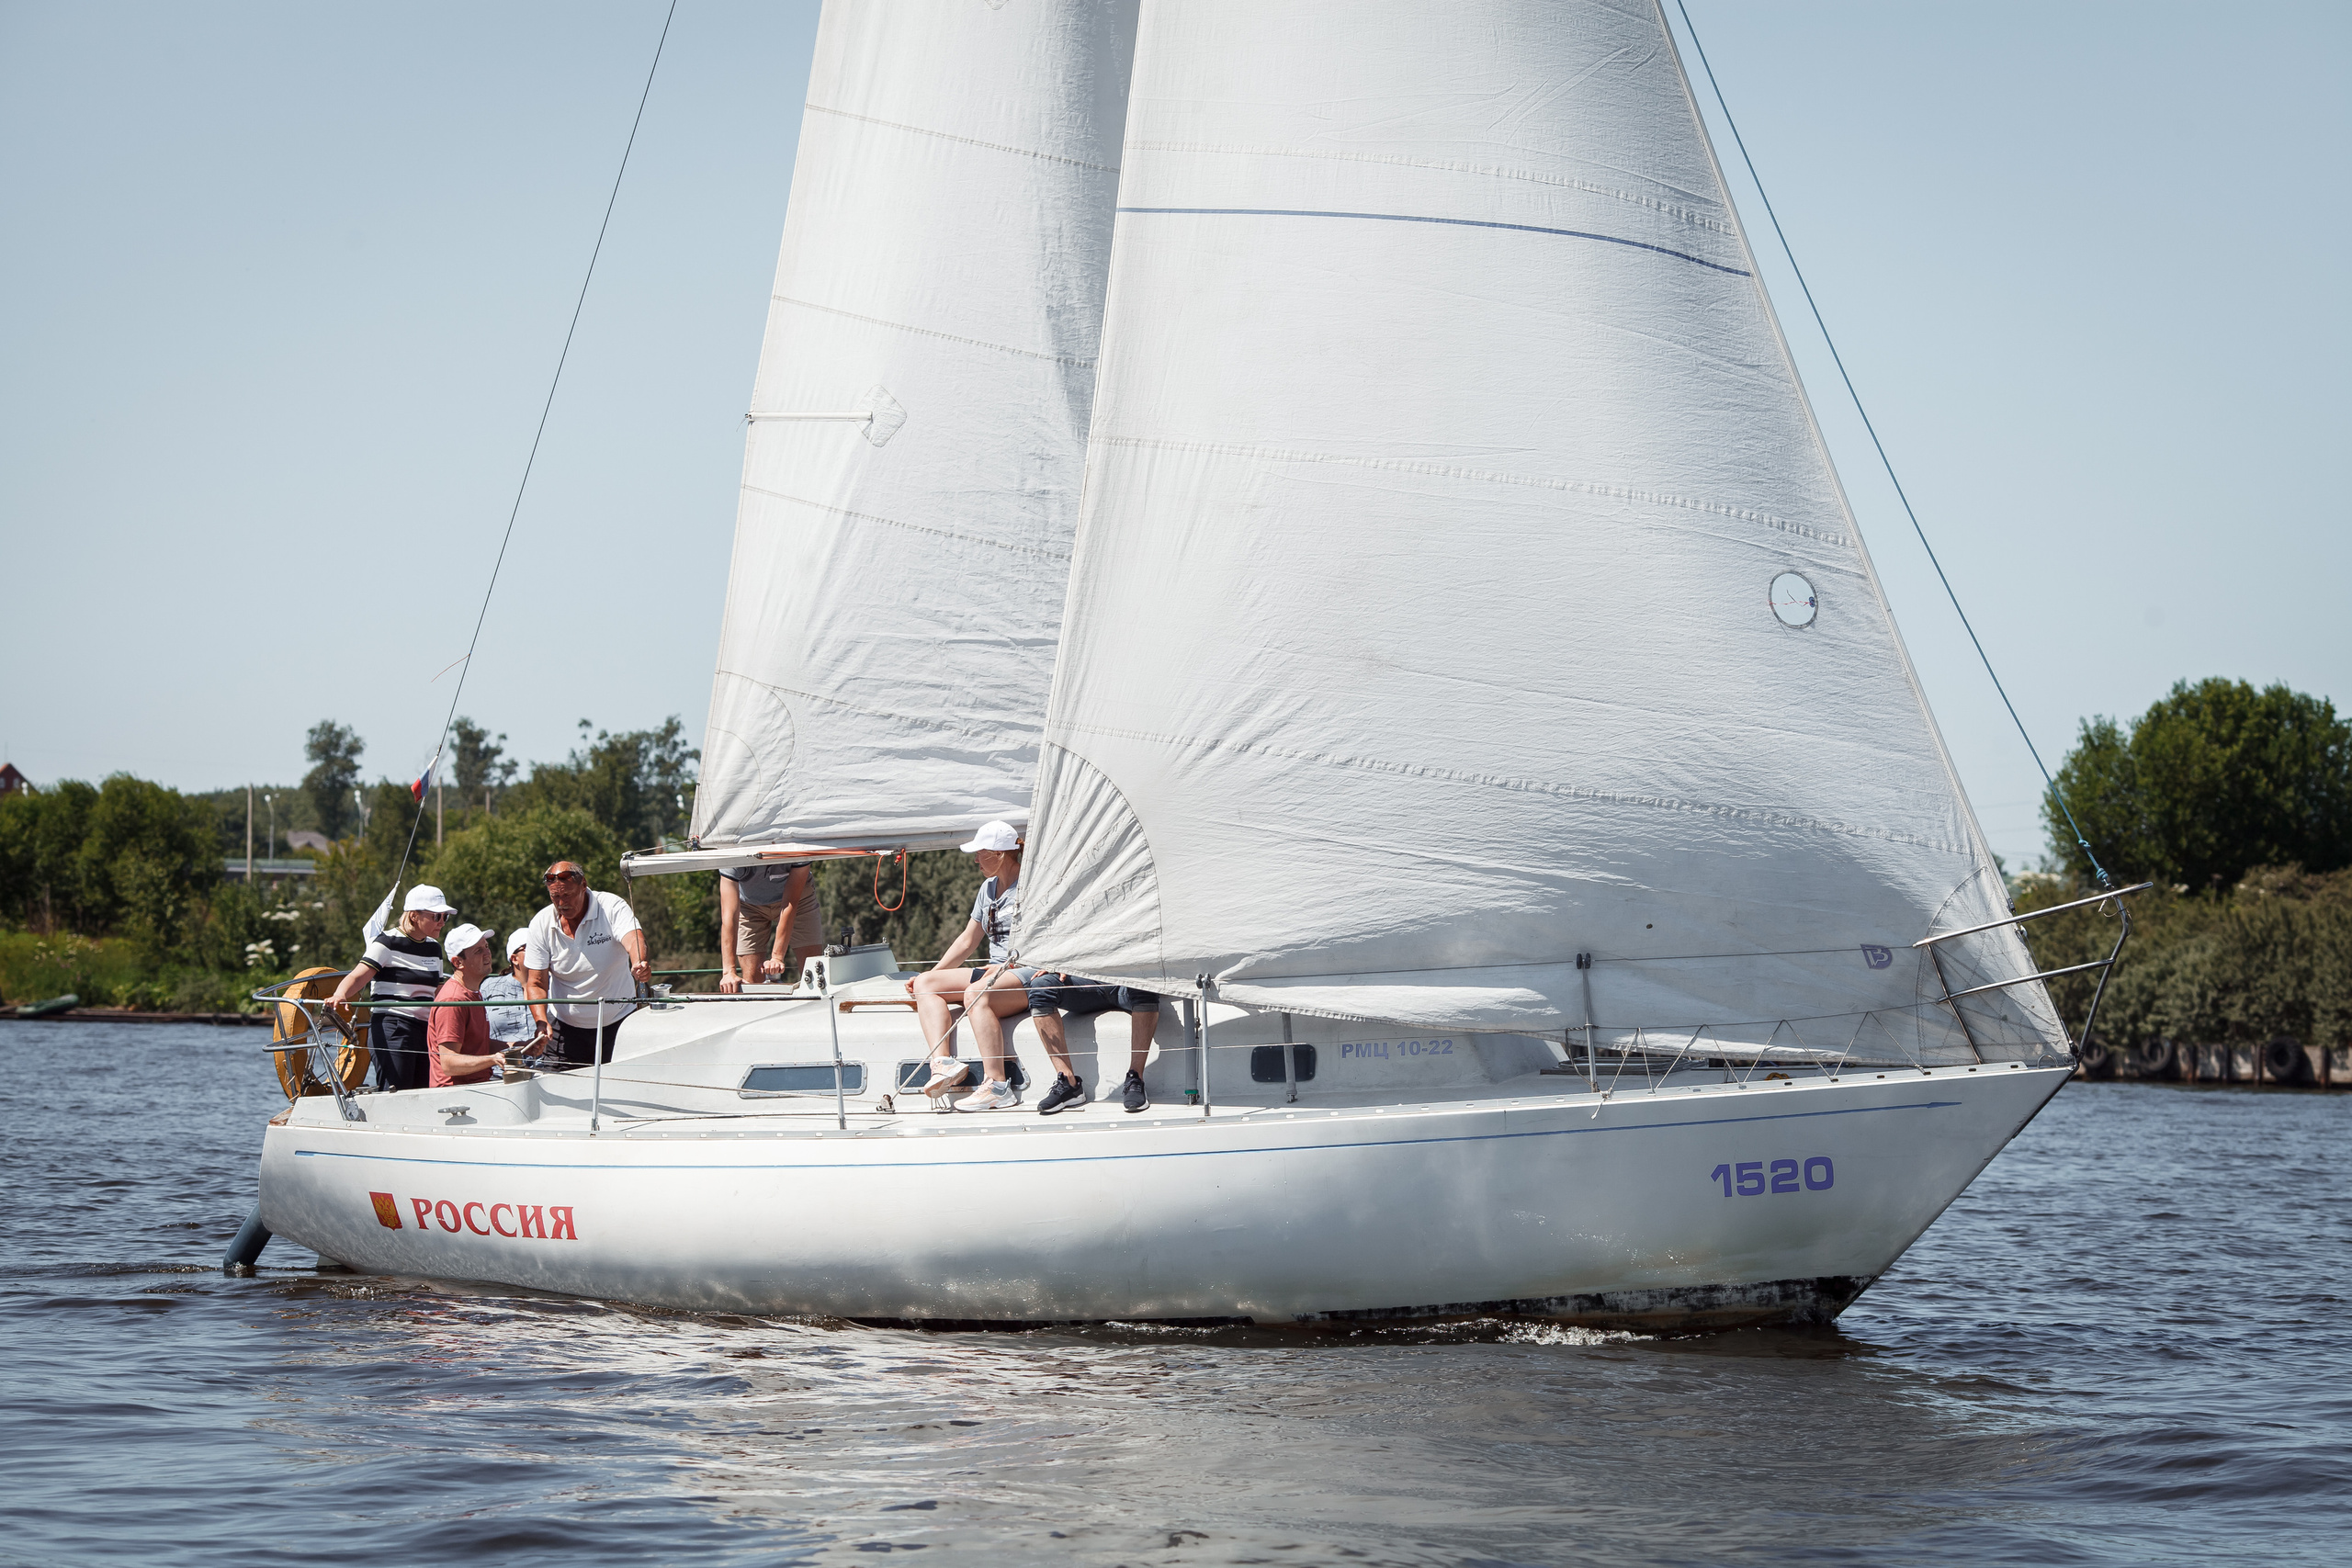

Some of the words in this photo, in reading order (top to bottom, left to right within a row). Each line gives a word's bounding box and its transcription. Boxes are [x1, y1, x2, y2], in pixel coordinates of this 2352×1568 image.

[587, 935, 612, 946] Skipper
[1341, 1042, 1389, 1060] РМЦ
[1396, 1039, 1453, 1056] 10-22
[1710, 1156, 1835, 1198] 1520
[410, 1197, 579, 1241] РОССИЯ
